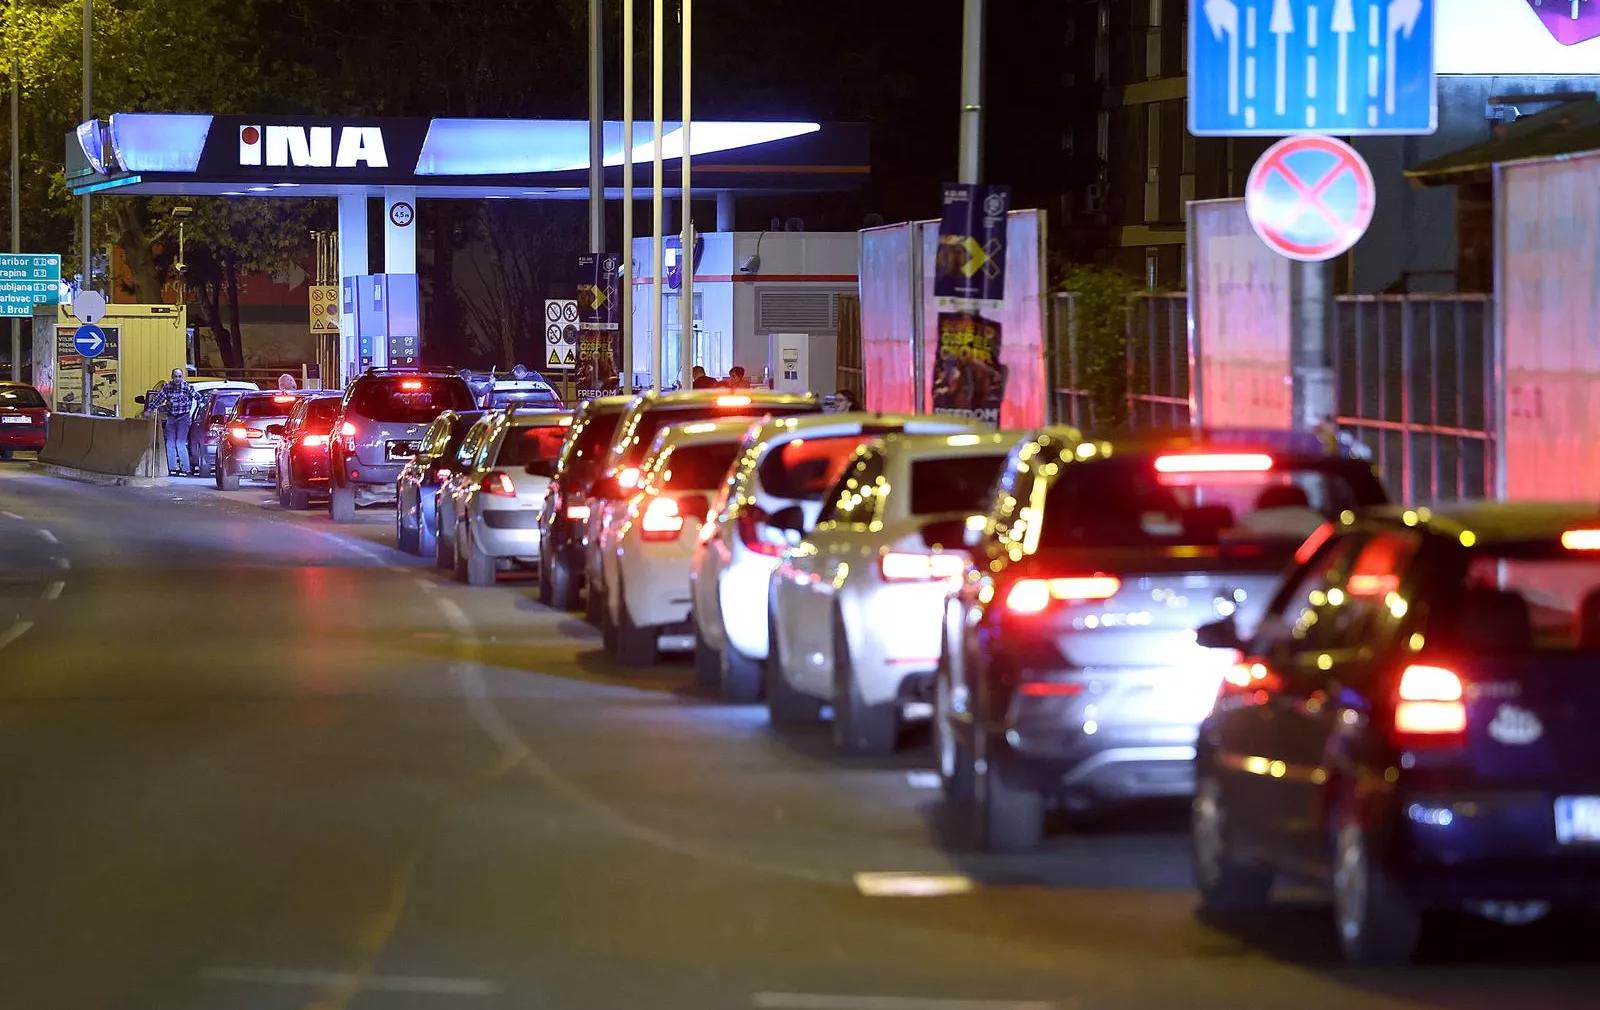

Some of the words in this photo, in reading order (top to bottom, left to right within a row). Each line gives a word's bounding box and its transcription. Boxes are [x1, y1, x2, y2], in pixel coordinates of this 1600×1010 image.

[240, 125, 388, 167] INA
[0, 258, 29, 266] aribor
[580, 342, 613, 351] GOSPEL
[577, 389, 617, 398] FREEDOM
